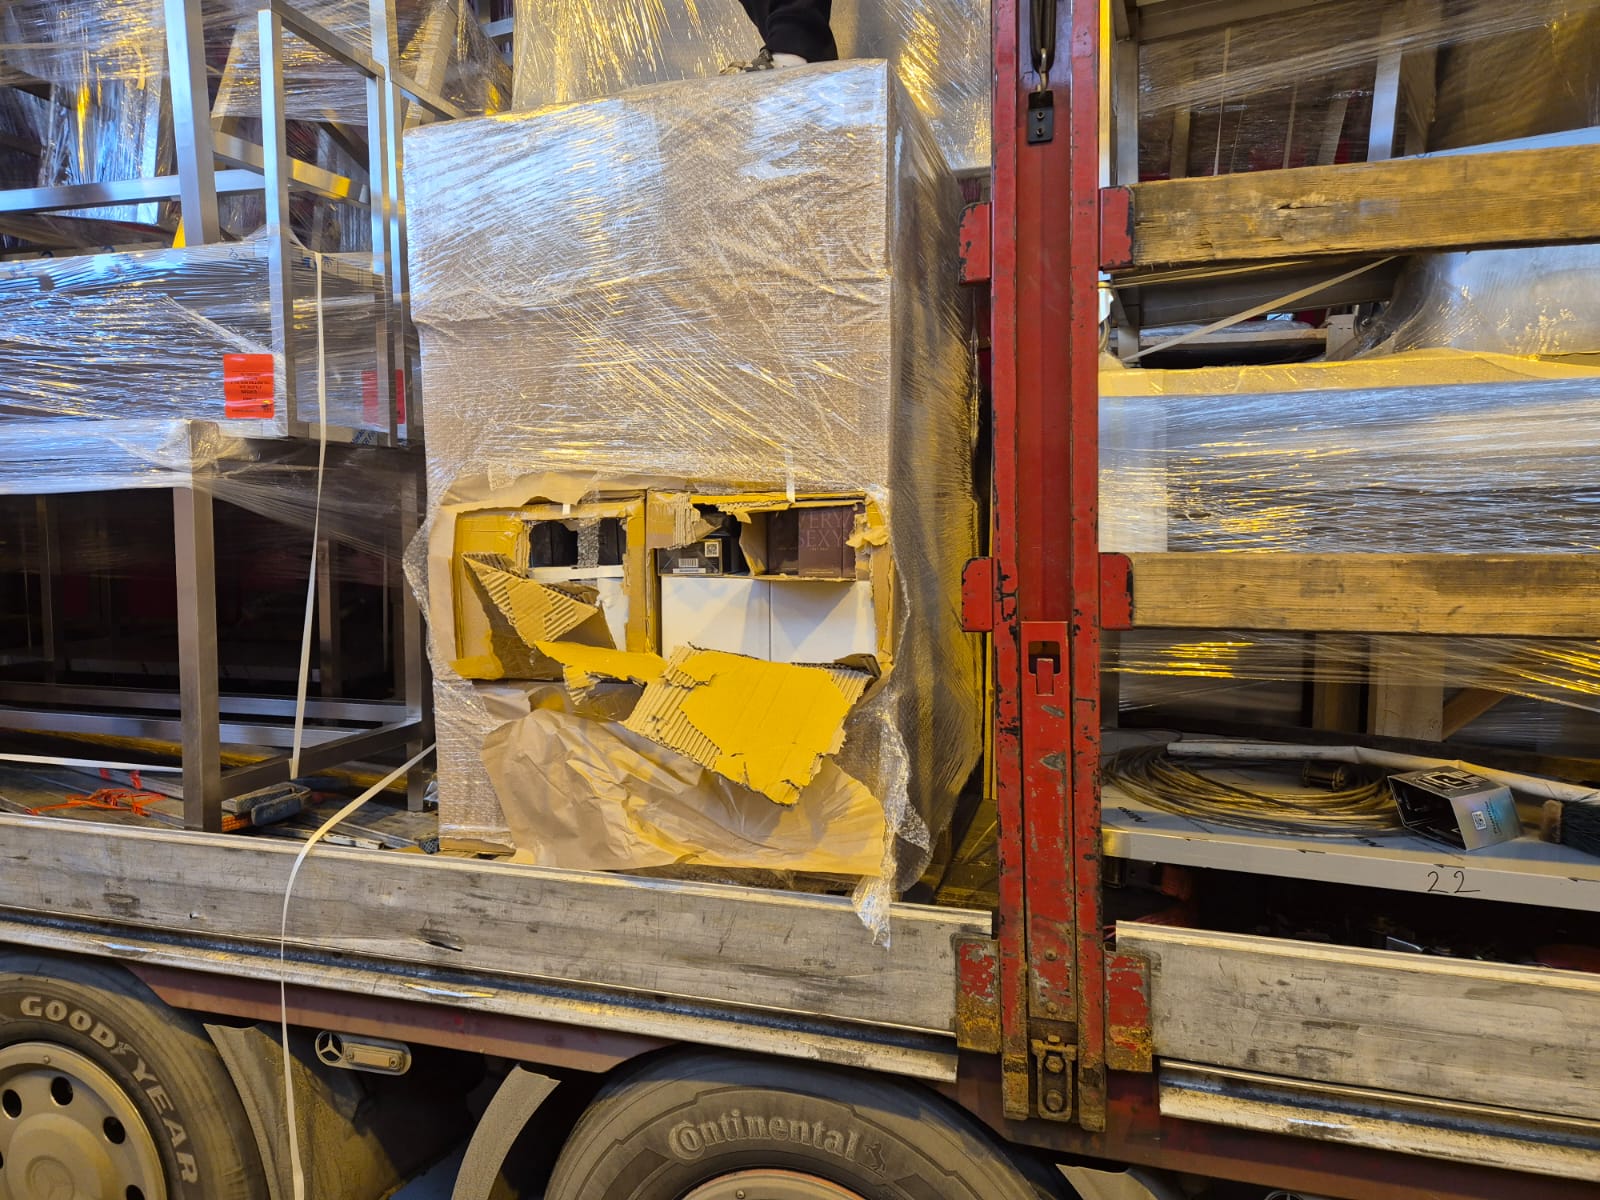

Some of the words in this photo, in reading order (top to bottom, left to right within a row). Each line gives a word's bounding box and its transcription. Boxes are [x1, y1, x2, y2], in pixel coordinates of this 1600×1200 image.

[1427, 870, 1481, 894] 22
[20, 996, 199, 1184] GOODYEAR
[668, 1108, 860, 1161] Continental
